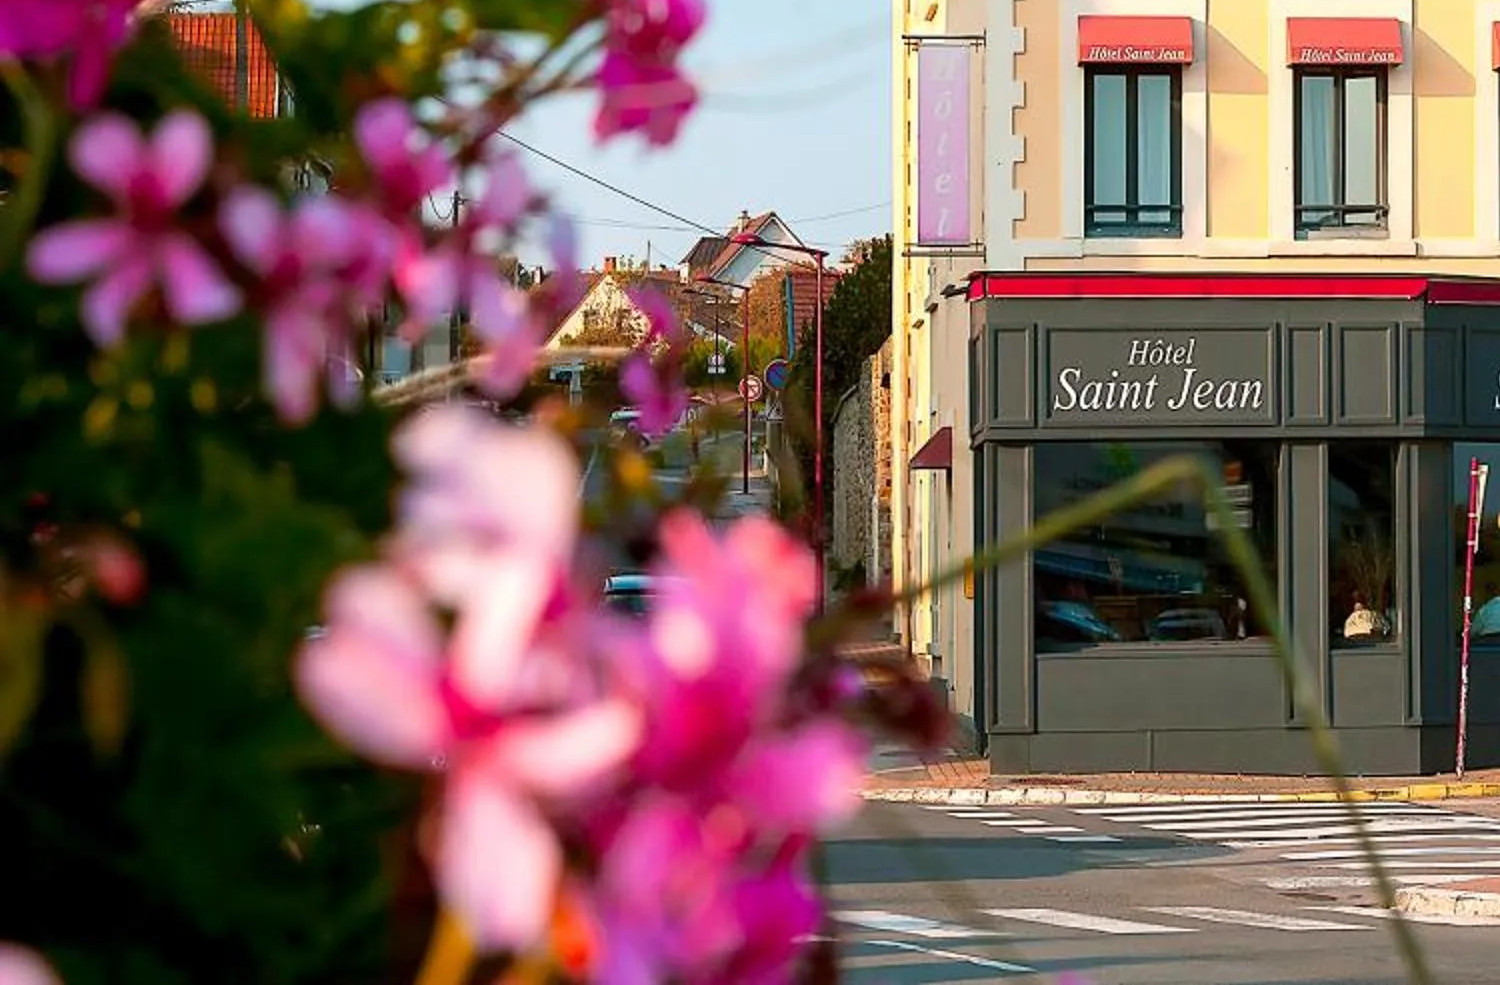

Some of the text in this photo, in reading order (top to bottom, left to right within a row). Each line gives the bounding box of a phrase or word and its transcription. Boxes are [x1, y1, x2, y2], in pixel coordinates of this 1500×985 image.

[1089, 46, 1185, 60] Hôtel Saint Jean
[1301, 48, 1396, 63] Hôtel Saint Jean
[1128, 338, 1196, 365] Hôtel
[1053, 367, 1263, 410] Saint Jean
